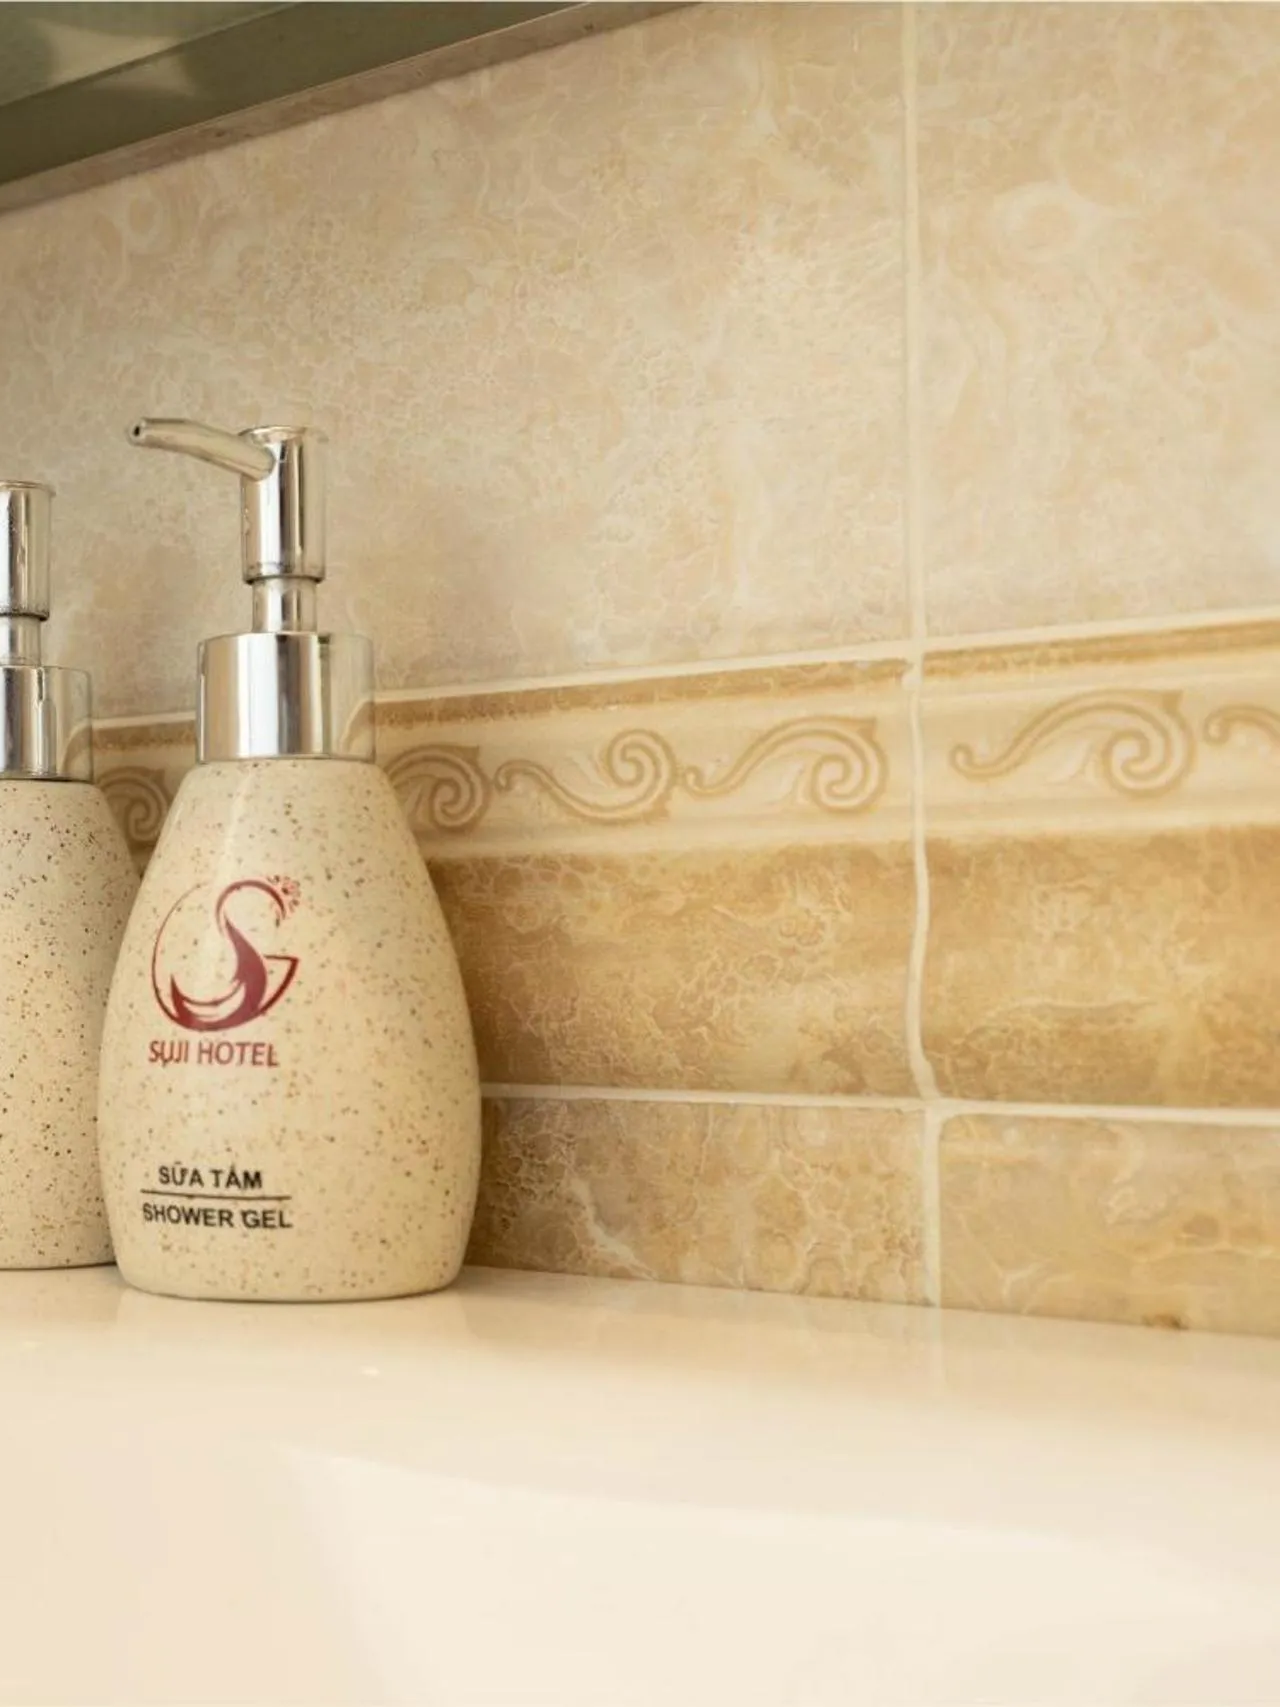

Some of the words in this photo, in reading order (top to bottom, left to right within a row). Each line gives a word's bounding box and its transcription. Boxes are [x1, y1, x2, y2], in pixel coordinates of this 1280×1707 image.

[148, 1040, 189, 1065] SUJI
[196, 1041, 280, 1067] HOTEL
[142, 1202, 234, 1228] SHOWER
[240, 1208, 293, 1229] GEL
